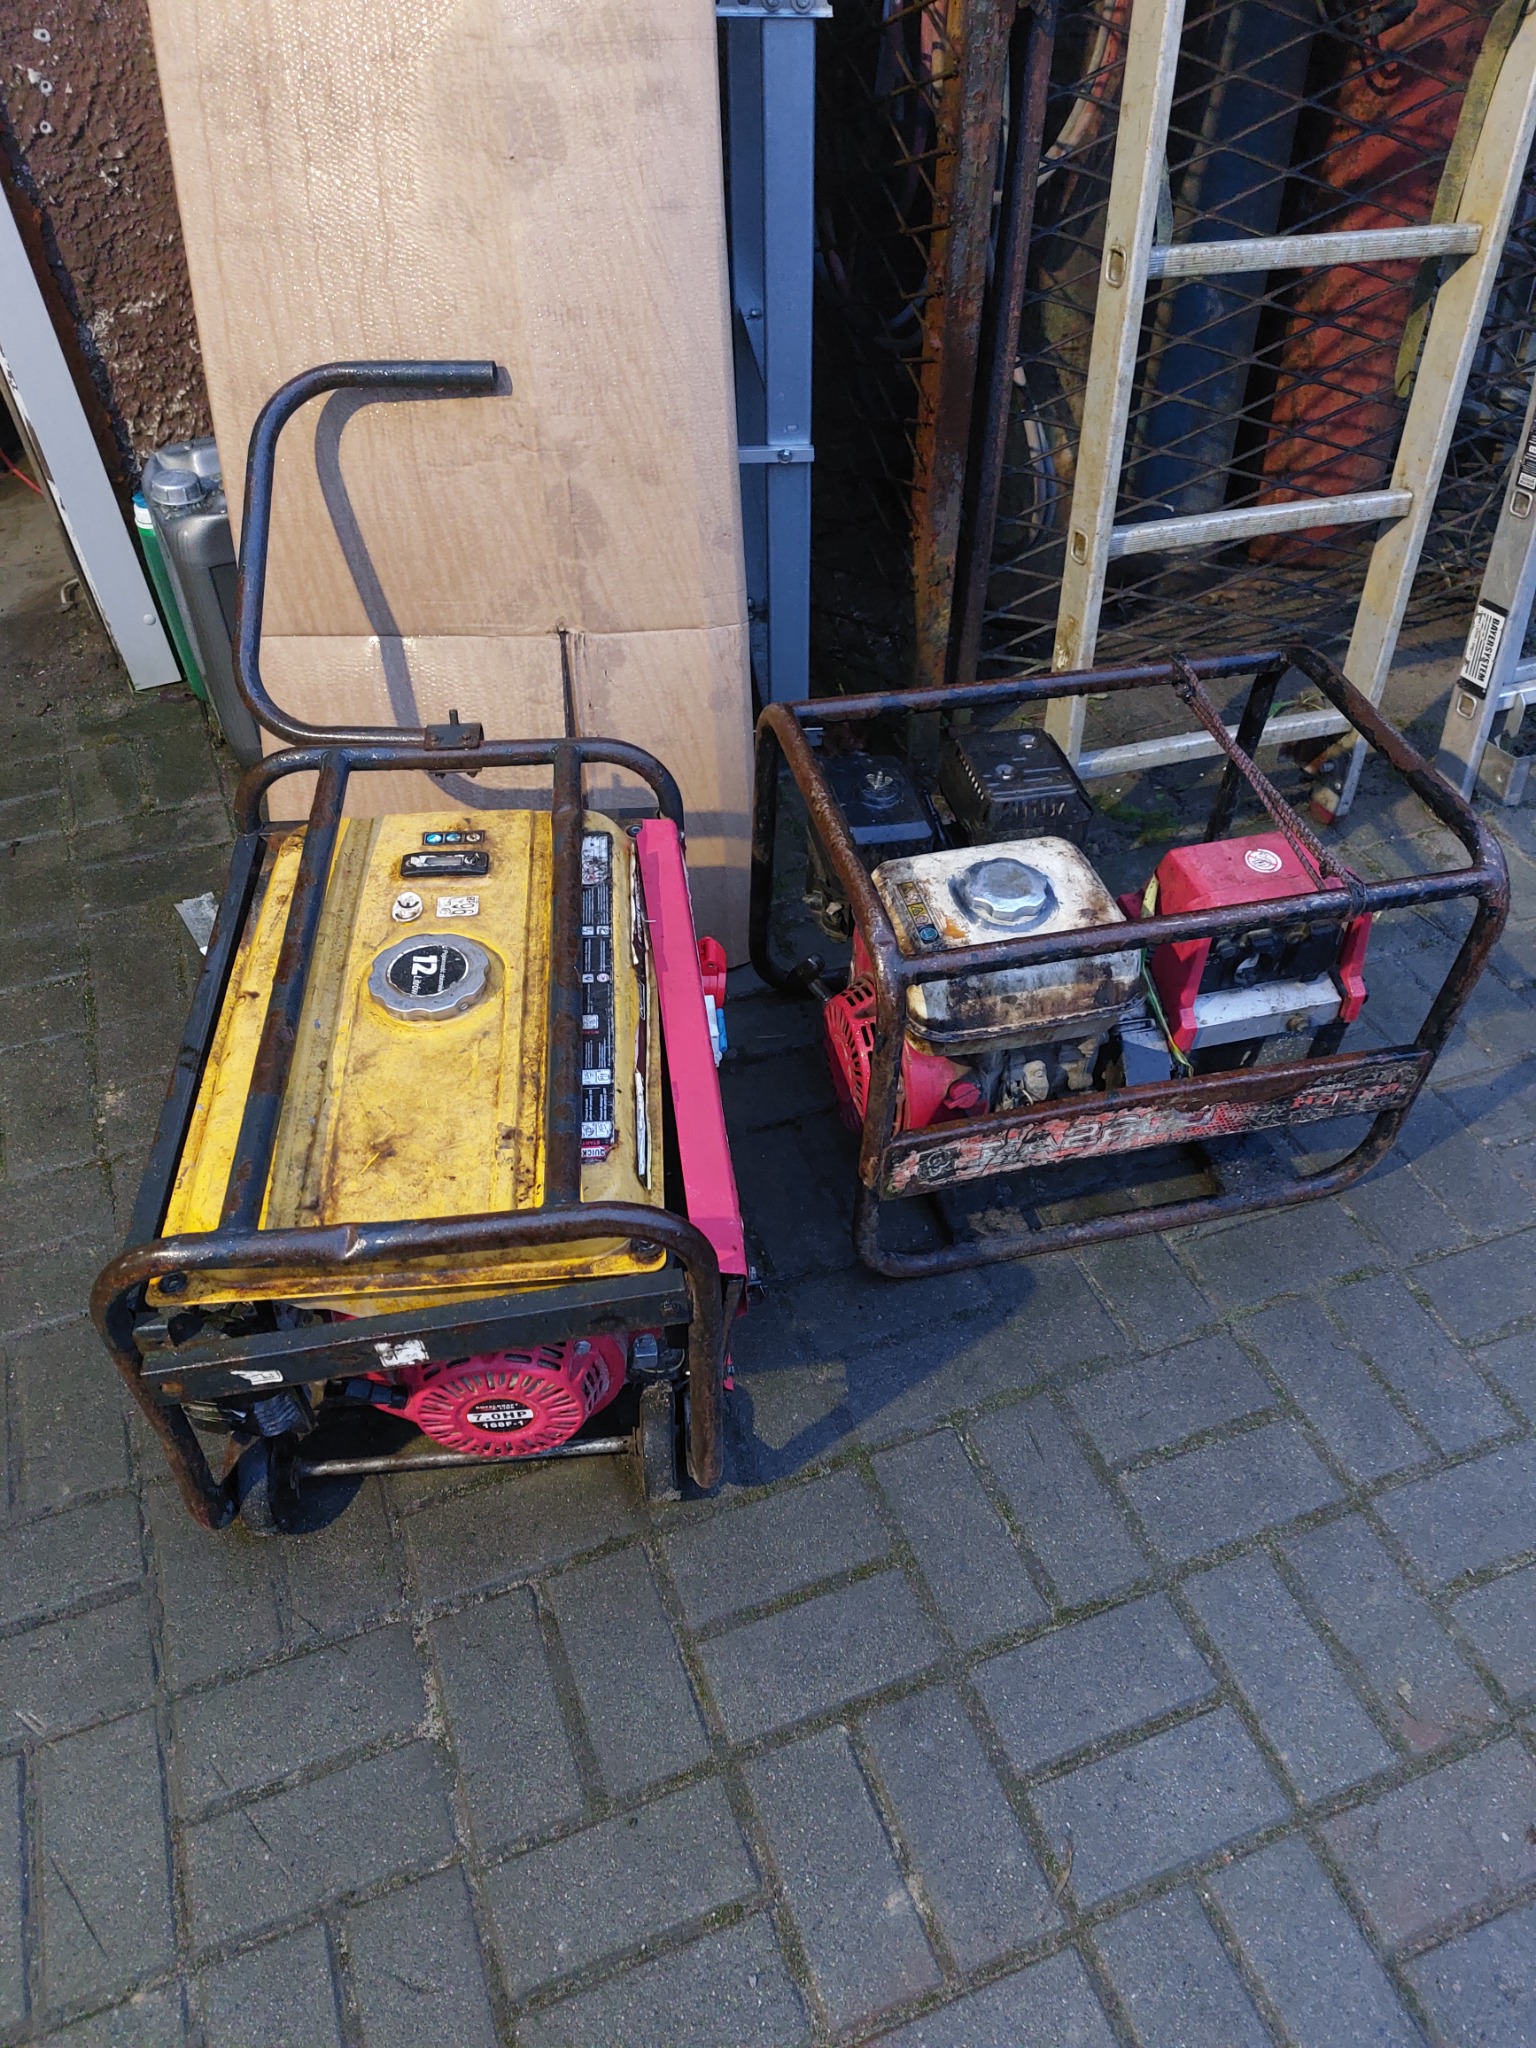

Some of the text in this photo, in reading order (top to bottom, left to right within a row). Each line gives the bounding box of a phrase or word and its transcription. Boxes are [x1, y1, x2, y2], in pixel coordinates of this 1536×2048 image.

[1478, 617, 1501, 682] BAYERSYSTEM
[411, 955, 438, 975] 12
[582, 1148, 606, 1157] QUICK
[472, 1411, 528, 1421] 7.0HP
